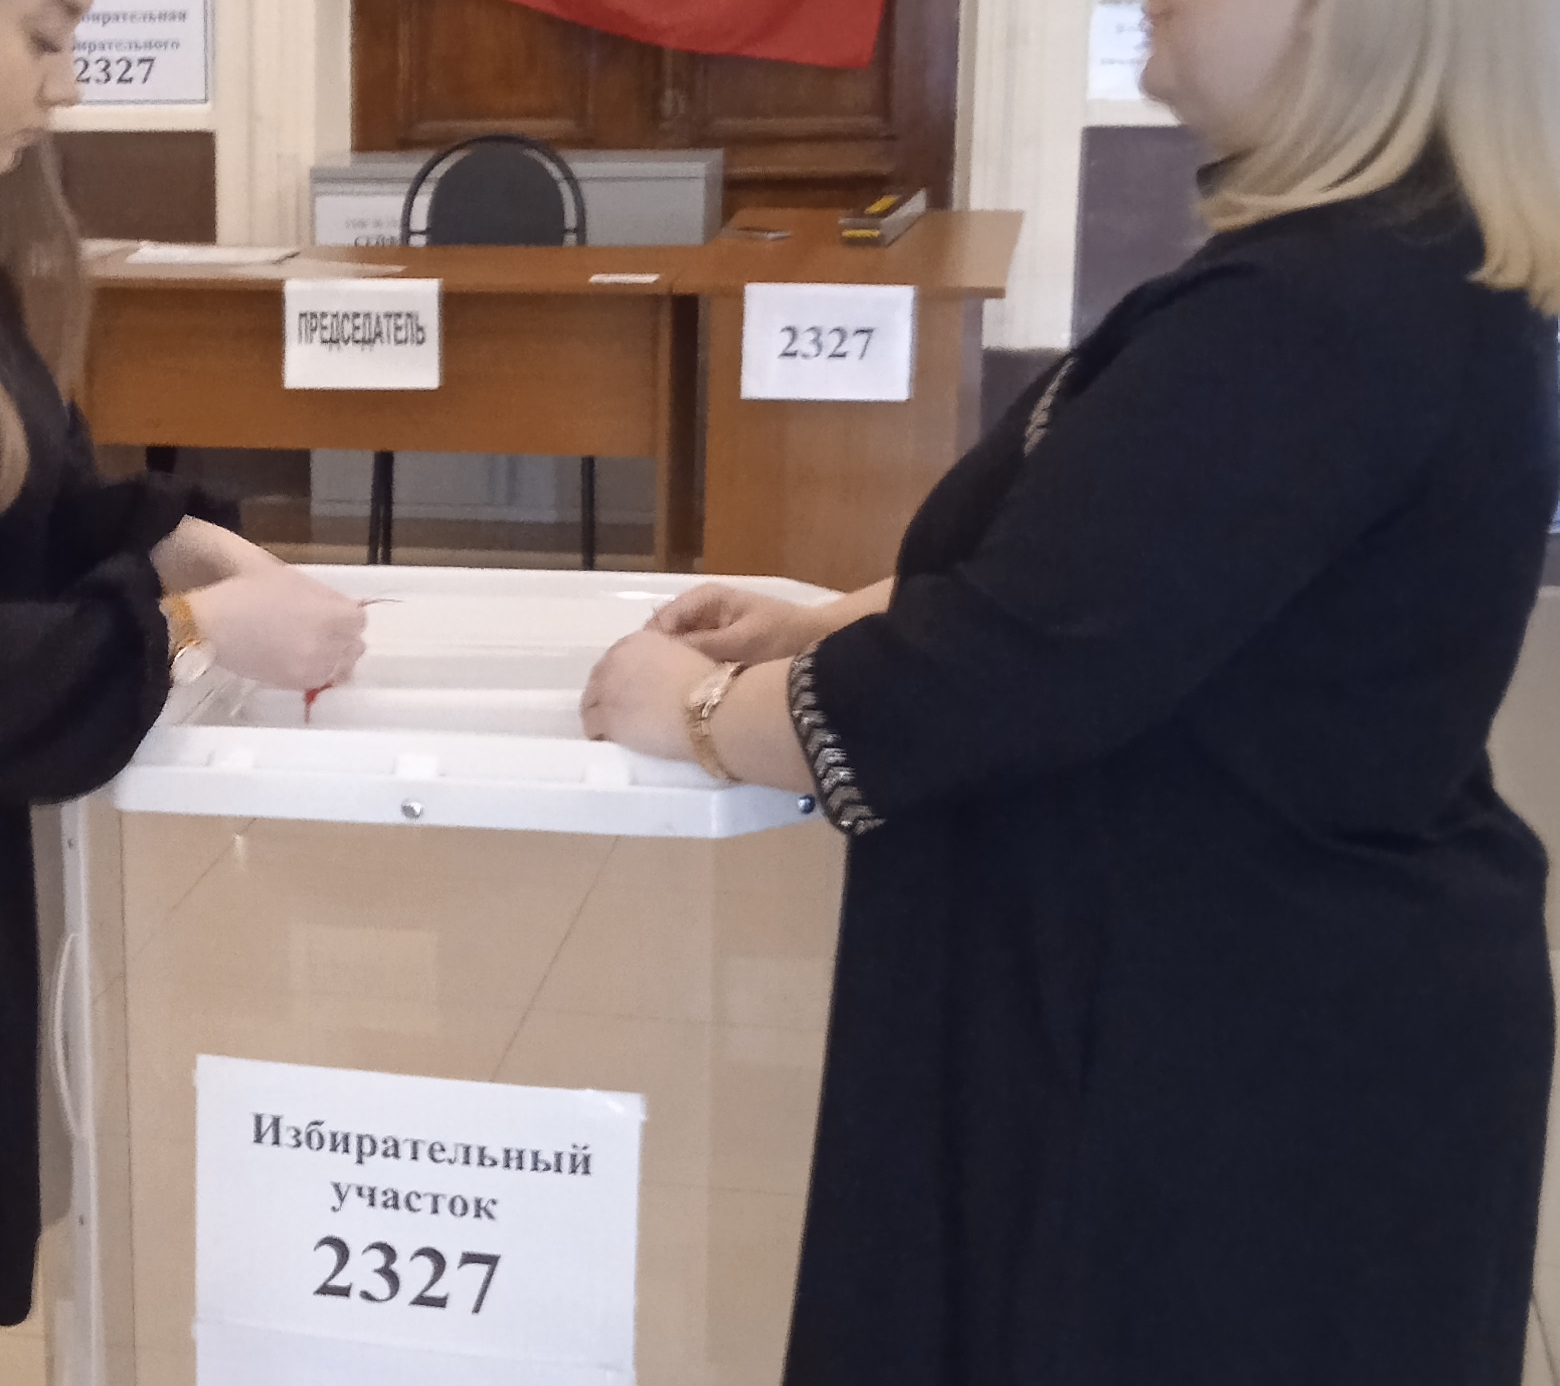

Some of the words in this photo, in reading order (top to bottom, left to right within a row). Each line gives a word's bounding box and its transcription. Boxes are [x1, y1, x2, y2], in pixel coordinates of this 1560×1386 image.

[73, 39, 180, 55] ирательного
[74, 56, 156, 84] 2327
[298, 311, 426, 351] ПРЕДСЕДАТЕЛЬ
[778, 324, 877, 361] 2327
[250, 1112, 594, 1177] Избирательный
[331, 1180, 498, 1222] участок
[312, 1235, 502, 1315] 2327
